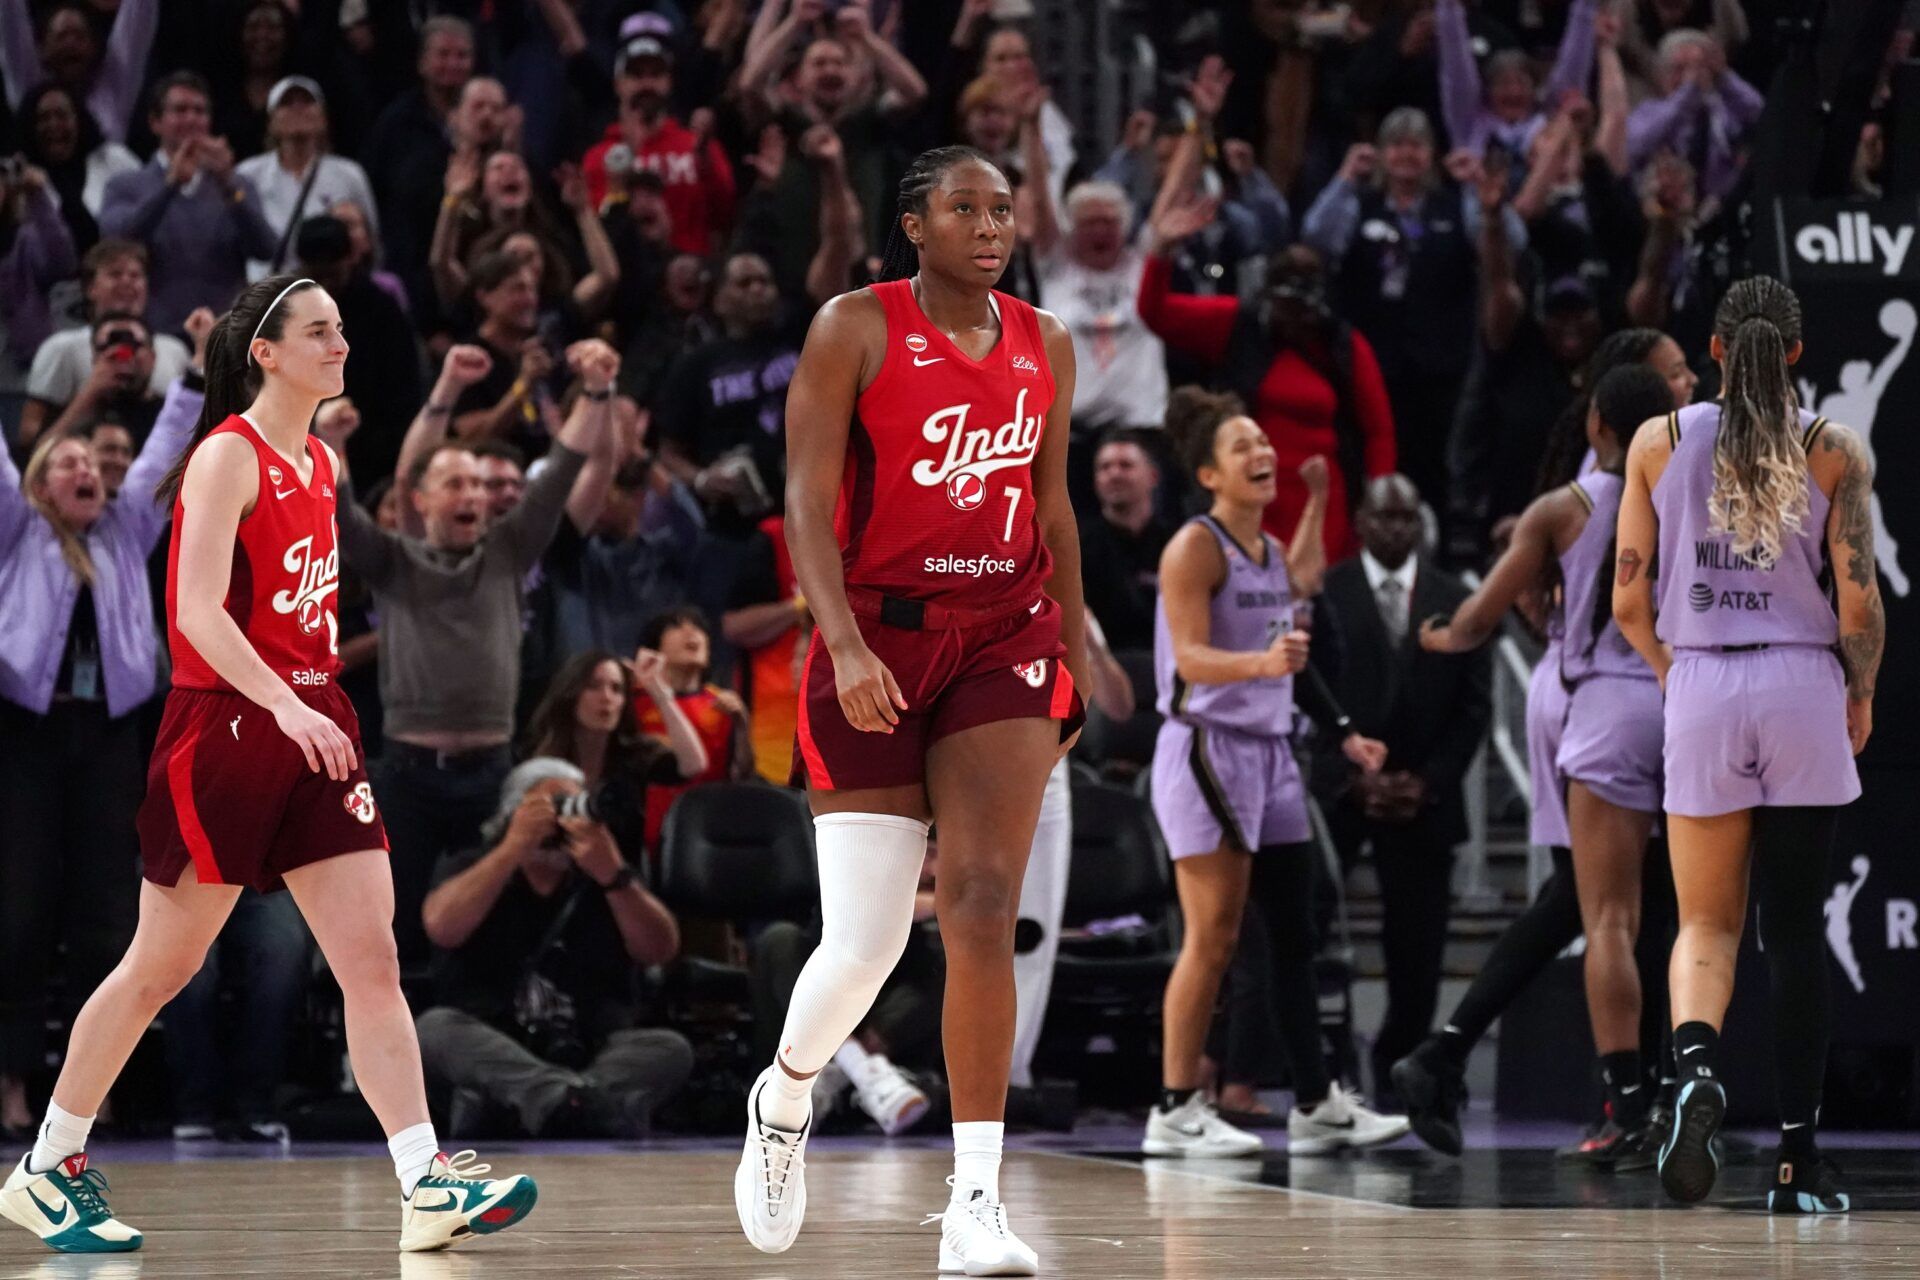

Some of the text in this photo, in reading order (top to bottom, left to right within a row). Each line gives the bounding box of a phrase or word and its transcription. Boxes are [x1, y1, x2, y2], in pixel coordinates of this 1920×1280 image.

[1795, 211, 1914, 275] ally
[1012, 355, 1039, 376] Lilly
[912, 387, 1043, 487] Indy
[1004, 486, 1023, 542] 7
[272, 513, 340, 614] Ind
[1719, 590, 1773, 612] AT&T
